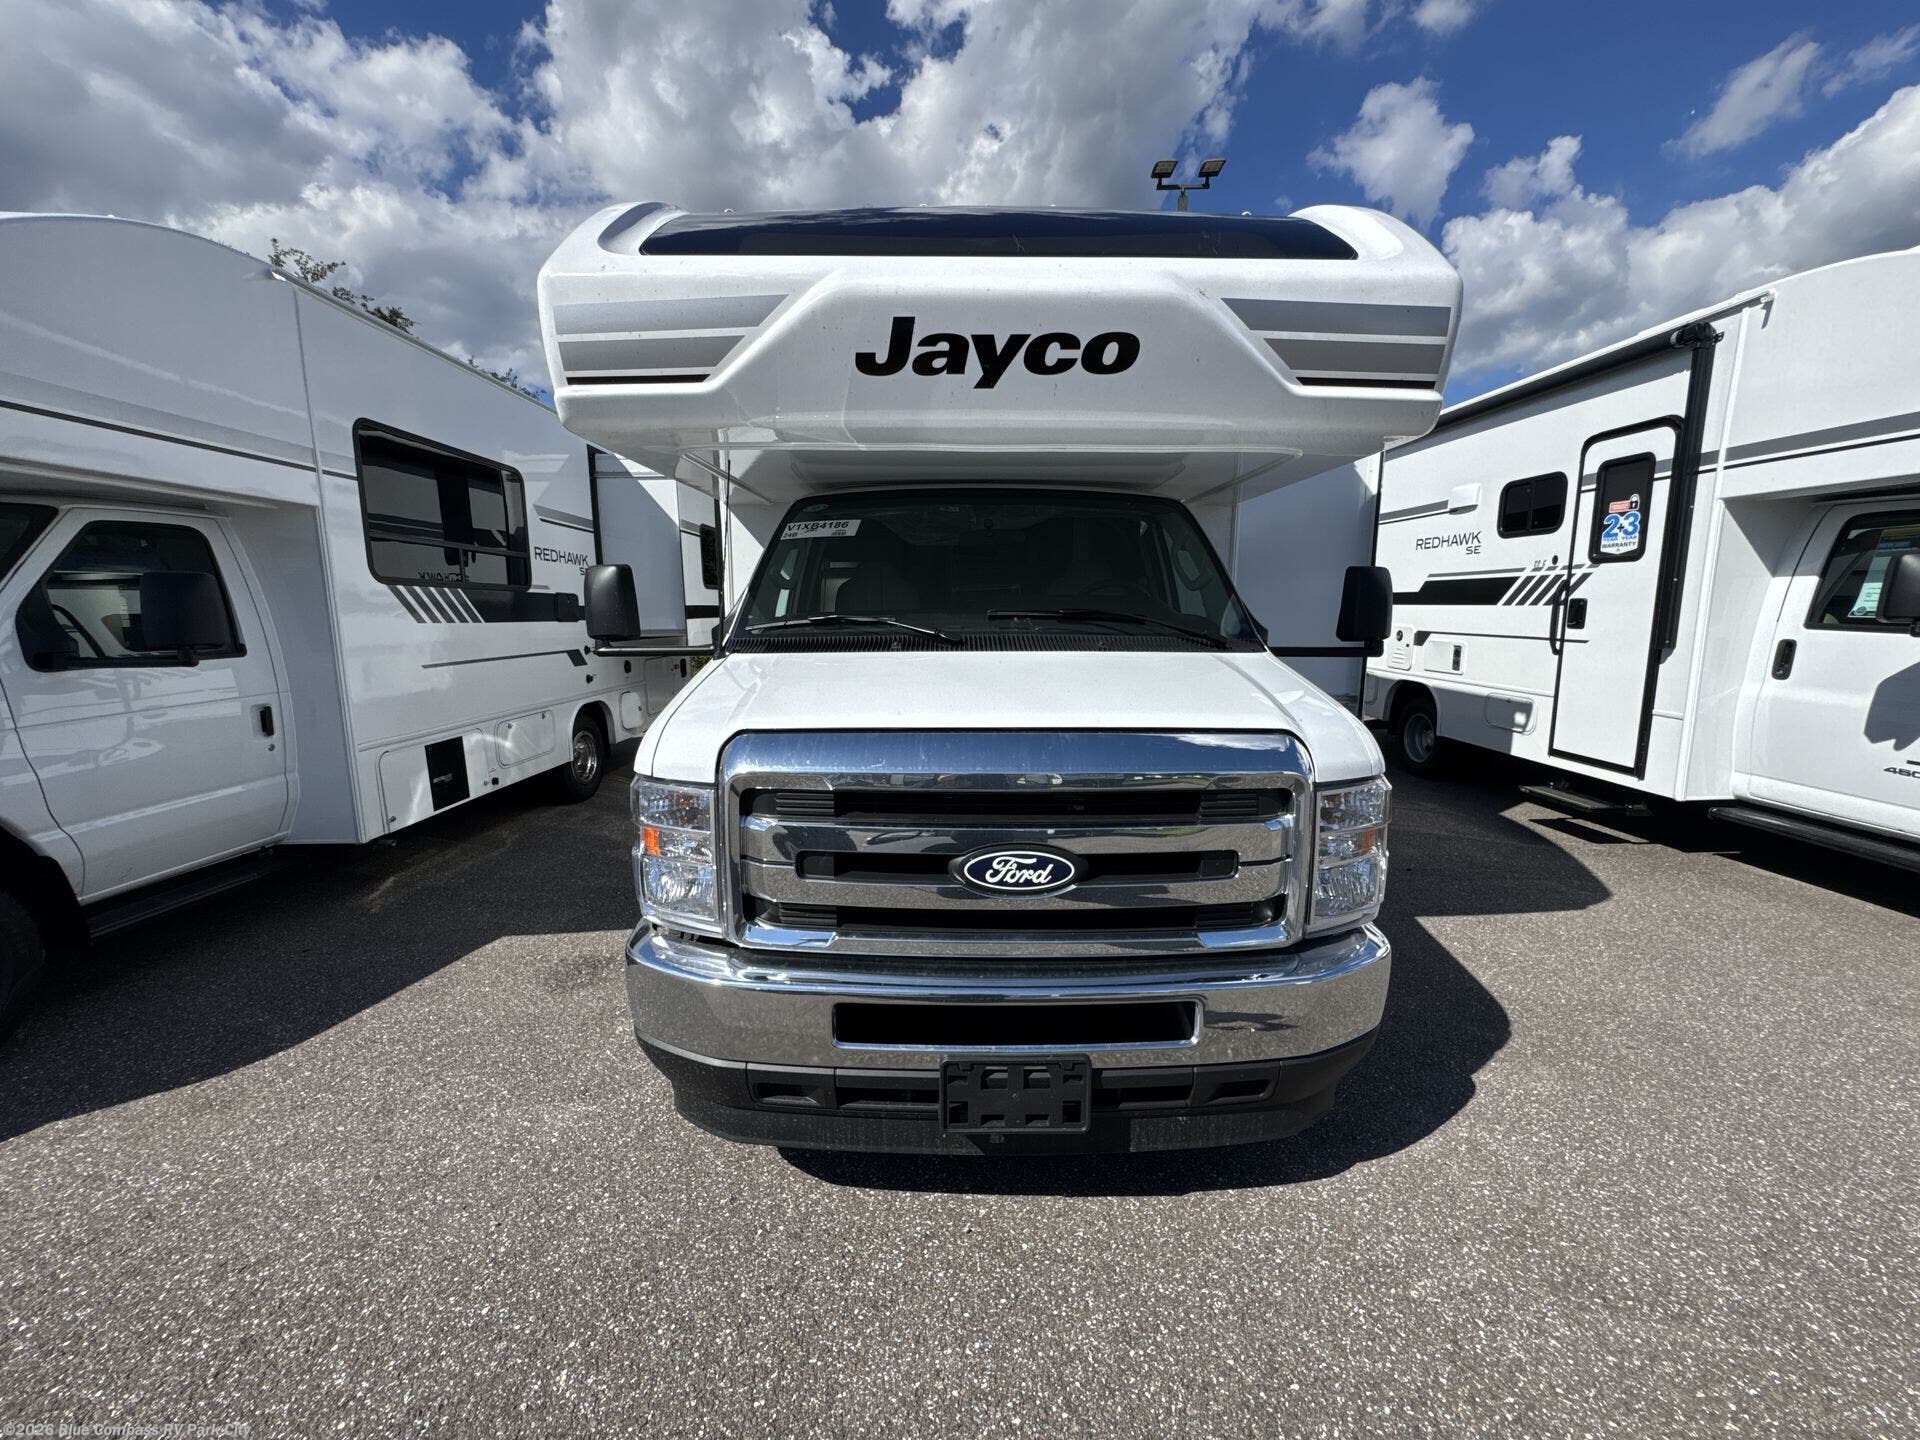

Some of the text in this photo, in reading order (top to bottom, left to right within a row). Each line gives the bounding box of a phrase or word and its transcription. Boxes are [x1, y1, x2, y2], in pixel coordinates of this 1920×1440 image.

[855, 316, 1141, 389] Jayco
[1415, 531, 1482, 550] REDHAWK
[1465, 545, 1481, 555] SE
[1602, 541, 1637, 549] WARRANTY
[534, 547, 589, 567] REDHAWK
[985, 856, 1054, 883] Ford
